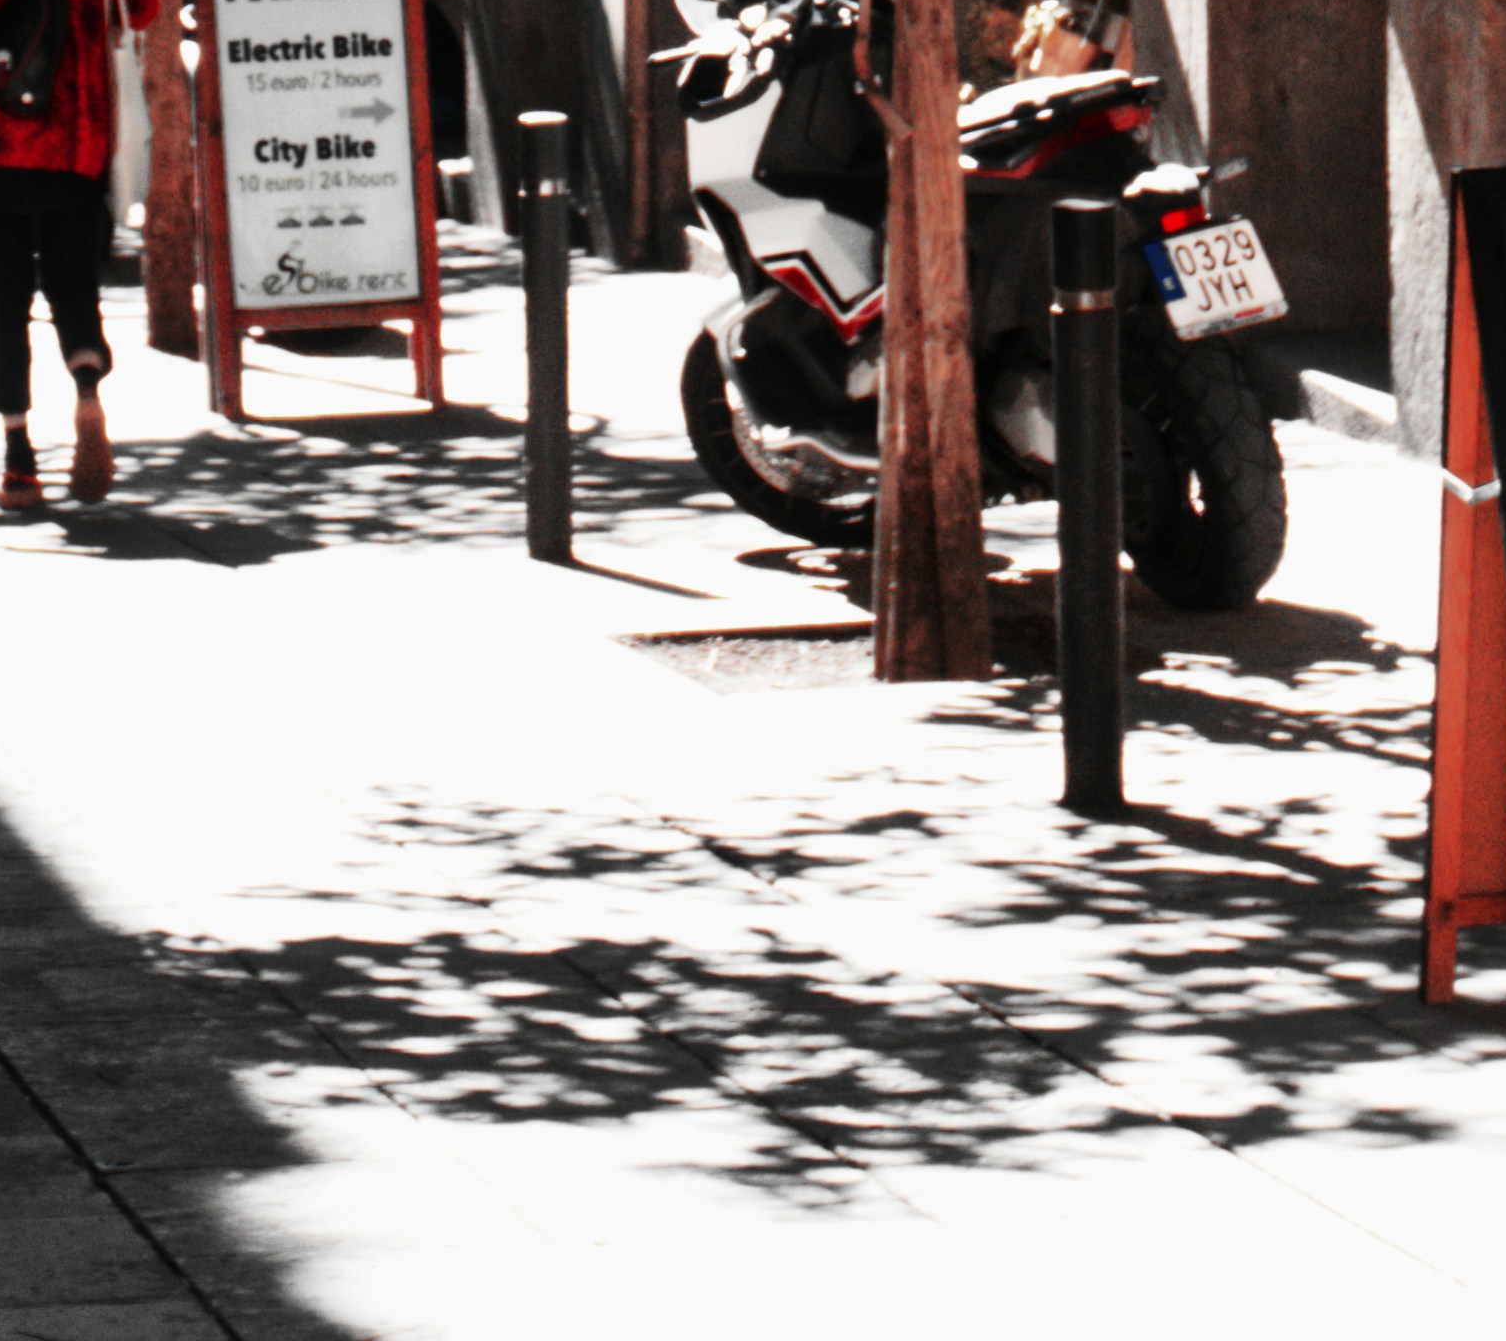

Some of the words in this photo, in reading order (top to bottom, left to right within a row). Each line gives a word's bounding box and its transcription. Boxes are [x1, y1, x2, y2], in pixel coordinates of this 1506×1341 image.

[228, 35, 325, 64] Electric
[333, 32, 393, 58] Bike
[247, 72, 266, 92] 15
[271, 76, 308, 92] euro
[321, 70, 331, 89] 2
[335, 69, 381, 87] hours
[254, 136, 307, 168] City
[316, 134, 376, 161] Bike
[239, 174, 260, 192] 10
[265, 177, 305, 193] euro
[320, 170, 342, 189] 24
[348, 169, 397, 186] hours
[1176, 229, 1256, 275] 0329
[1198, 269, 1253, 311] JYH
